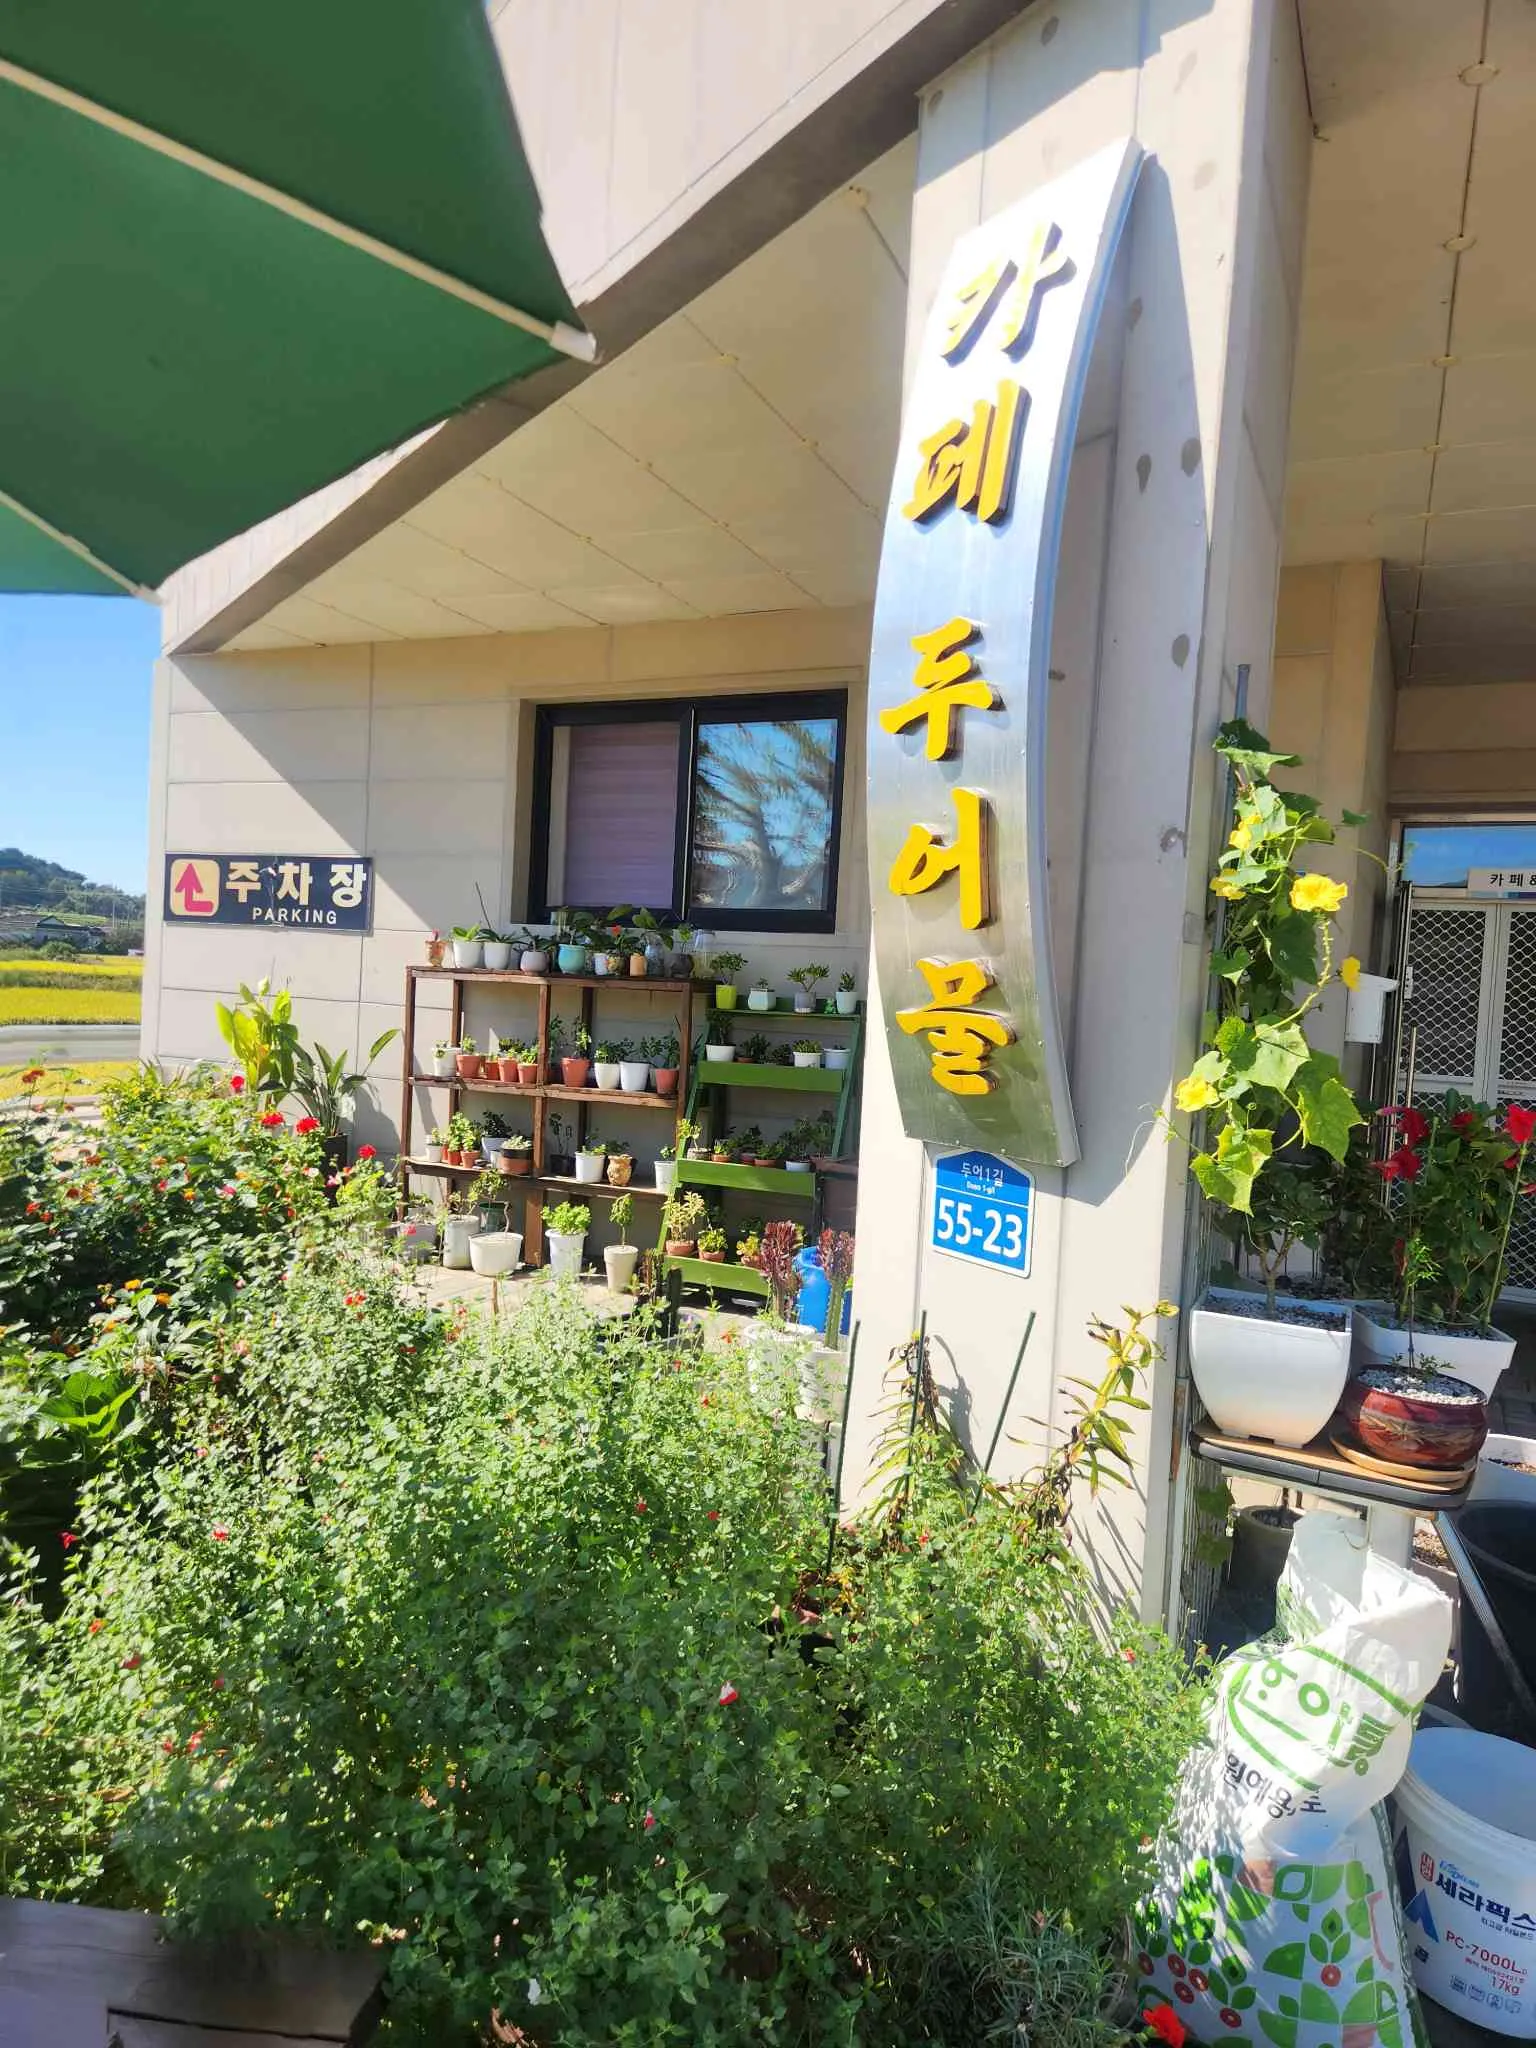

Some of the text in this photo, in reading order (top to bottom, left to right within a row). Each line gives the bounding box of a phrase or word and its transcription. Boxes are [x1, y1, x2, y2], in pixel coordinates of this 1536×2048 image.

[879, 222, 1076, 1097] 카페 두어물
[225, 862, 367, 908] 주차장
[252, 907, 337, 925] PARKING
[961, 1162, 1004, 1187] 두어1길
[937, 1197, 1023, 1258] 55-23
[1436, 1872, 1536, 1932] 세라픽스
[1446, 1930, 1522, 1974] PC-7000L
